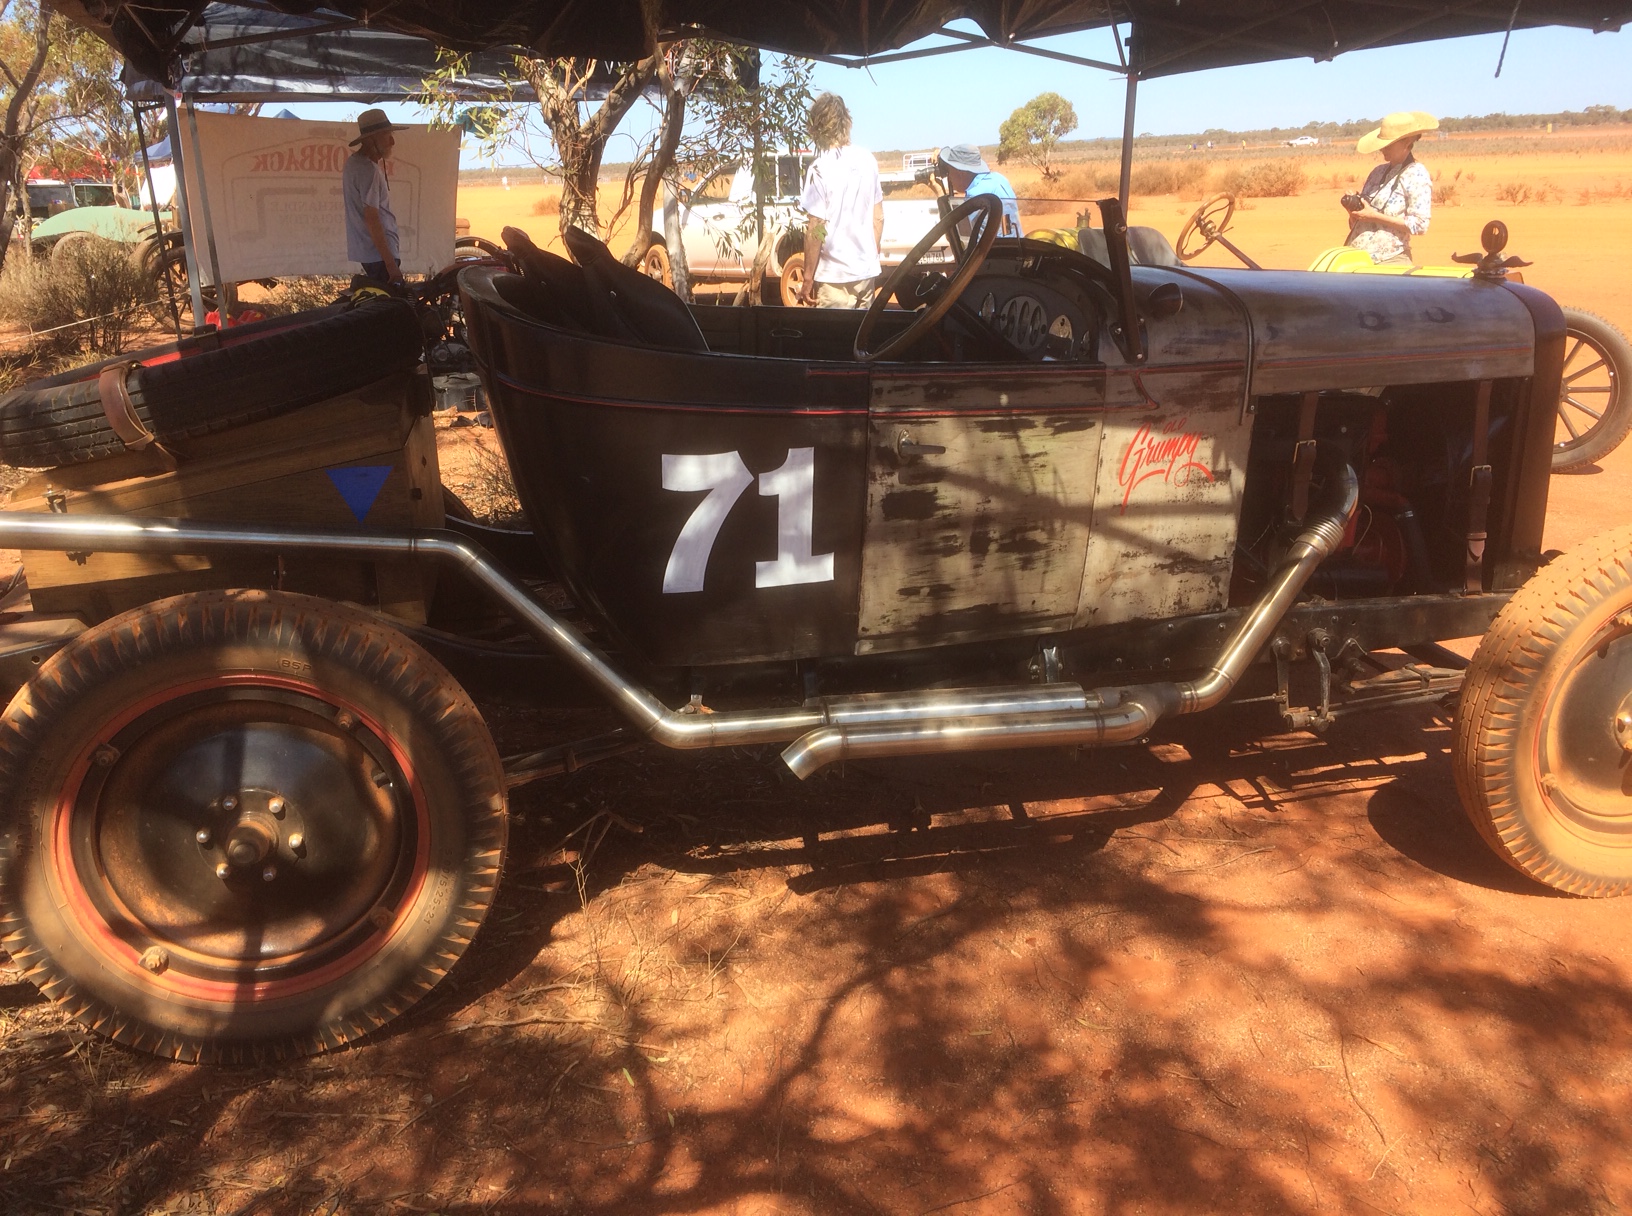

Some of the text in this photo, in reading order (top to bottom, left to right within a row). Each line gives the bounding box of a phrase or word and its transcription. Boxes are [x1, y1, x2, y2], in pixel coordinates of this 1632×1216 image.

[1118, 422, 1214, 516] Grumpy
[661, 446, 835, 594] 71
[423, 848, 453, 925] 500/5.25-21
